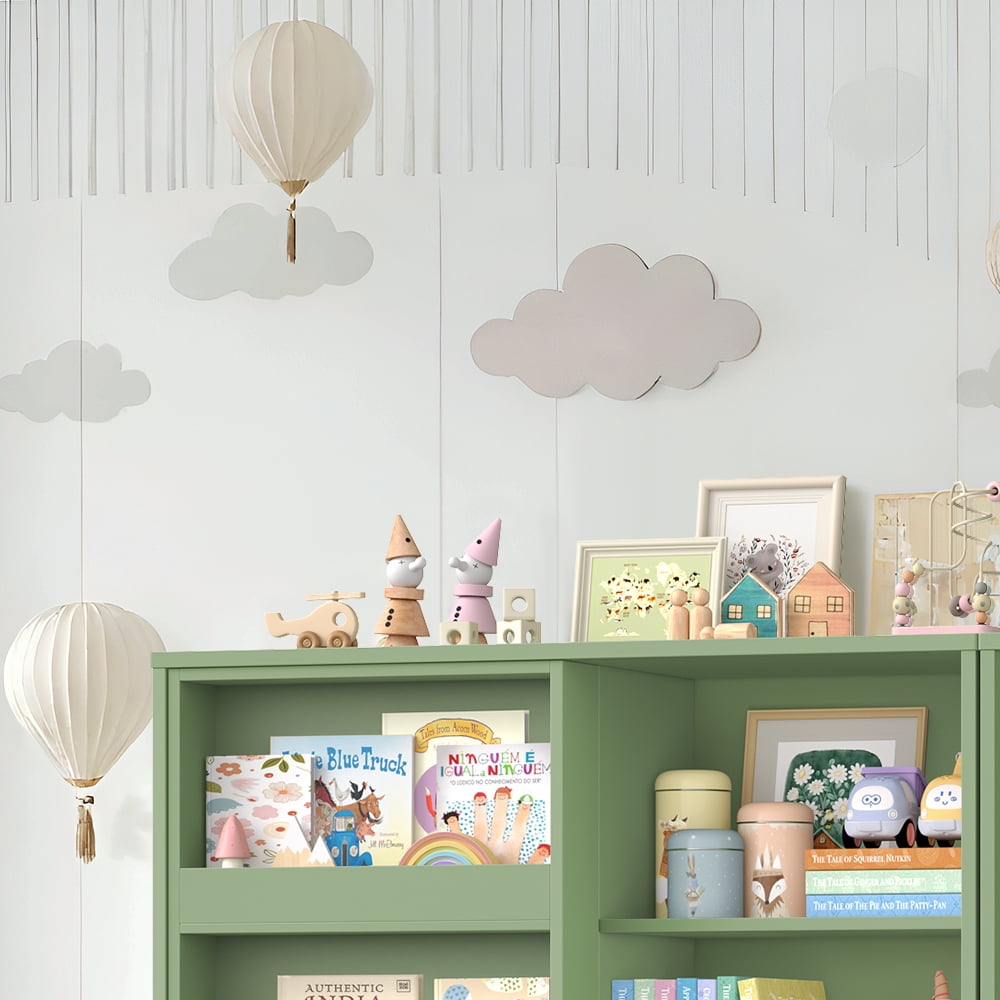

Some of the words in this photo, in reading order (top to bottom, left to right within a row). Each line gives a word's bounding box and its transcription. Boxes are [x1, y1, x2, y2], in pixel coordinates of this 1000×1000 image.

[525, 749, 535, 763] É
[327, 747, 360, 770] Blue
[361, 747, 407, 776] Truck
[812, 855, 825, 863] THE
[827, 855, 843, 863] TALE
[813, 902, 826, 910] THE
[827, 902, 844, 910] TALE
[855, 901, 867, 910] THE
[869, 901, 880, 910] PIE
[896, 901, 909, 909] THE
[304, 984, 384, 993] AUTHENTIC
